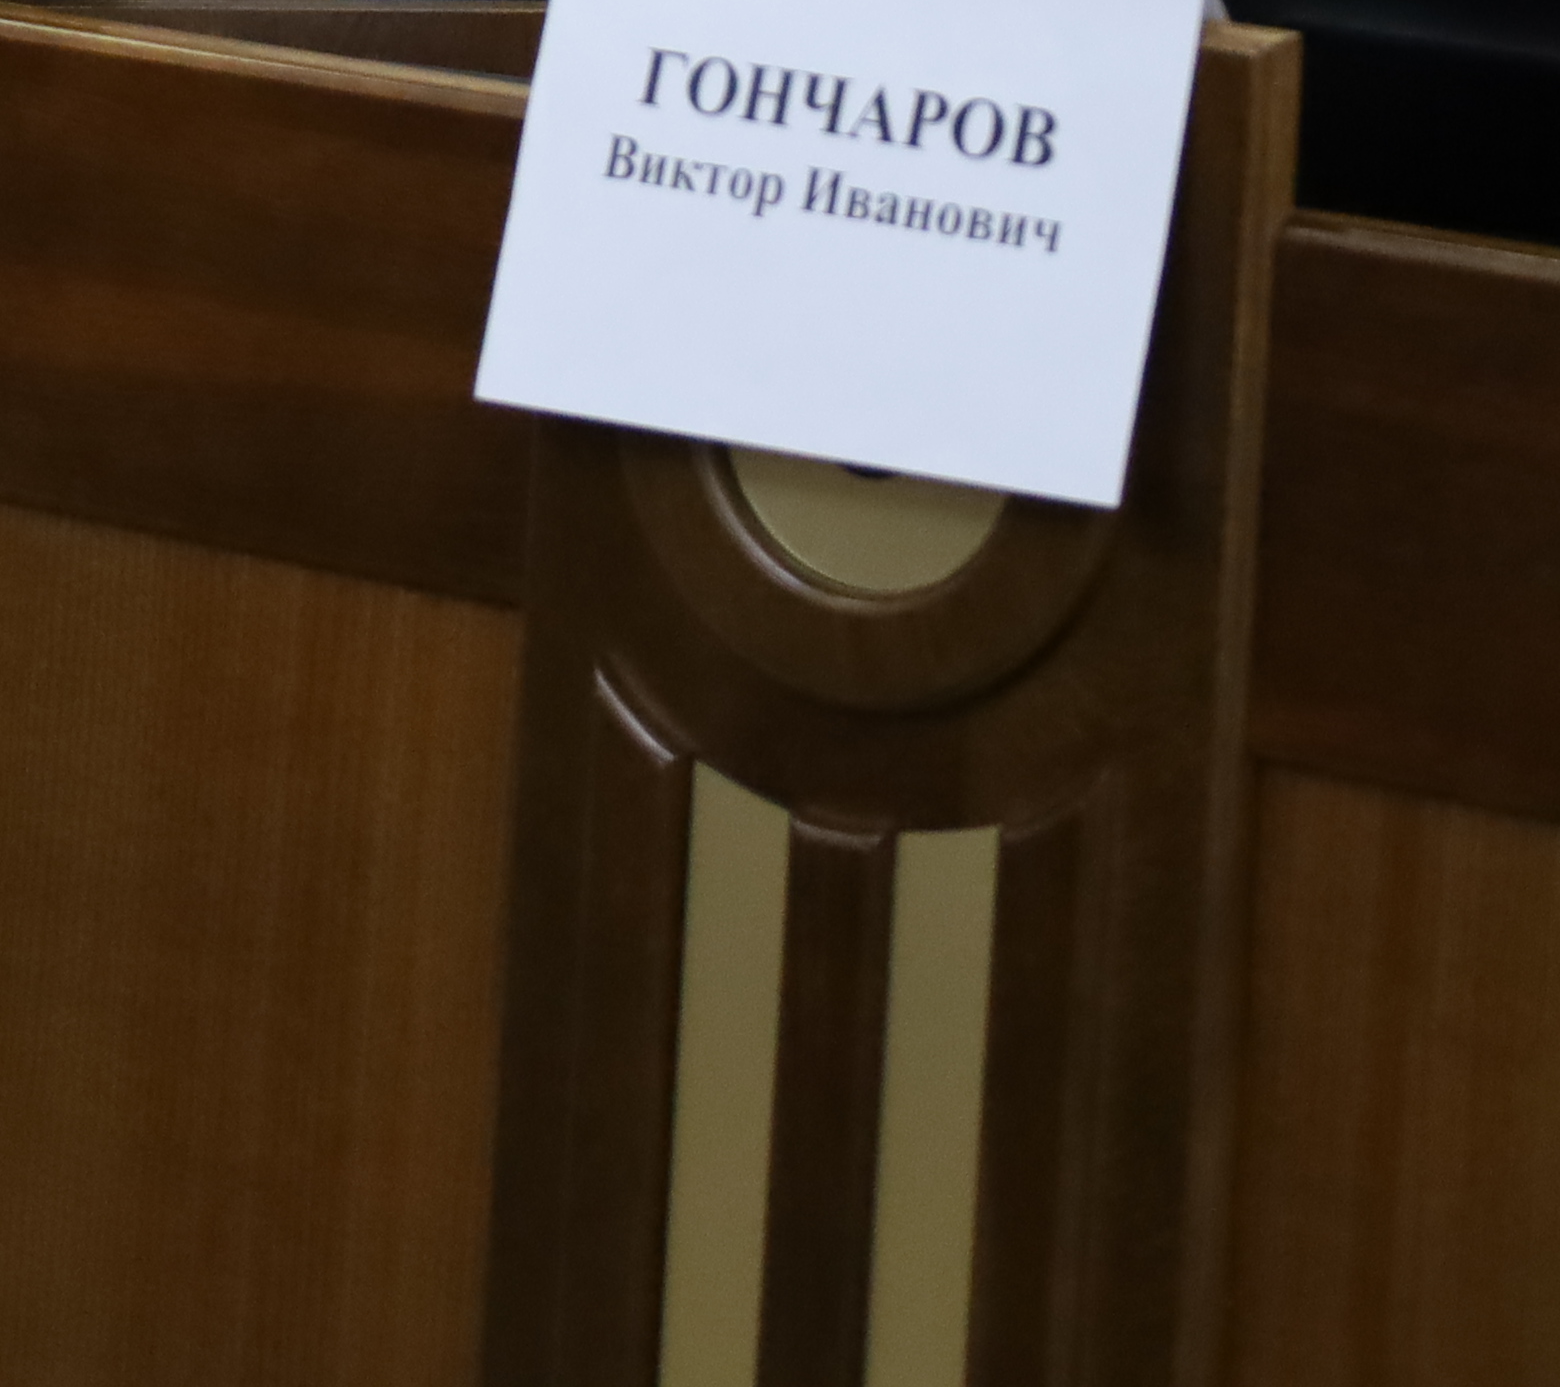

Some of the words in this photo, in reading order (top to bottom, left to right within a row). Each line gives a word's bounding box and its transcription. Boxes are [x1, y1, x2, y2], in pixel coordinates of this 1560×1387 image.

[639, 47, 1059, 169] ГОНЧАРОВ
[603, 134, 786, 219] Виктор
[800, 166, 1062, 254] Иванович
